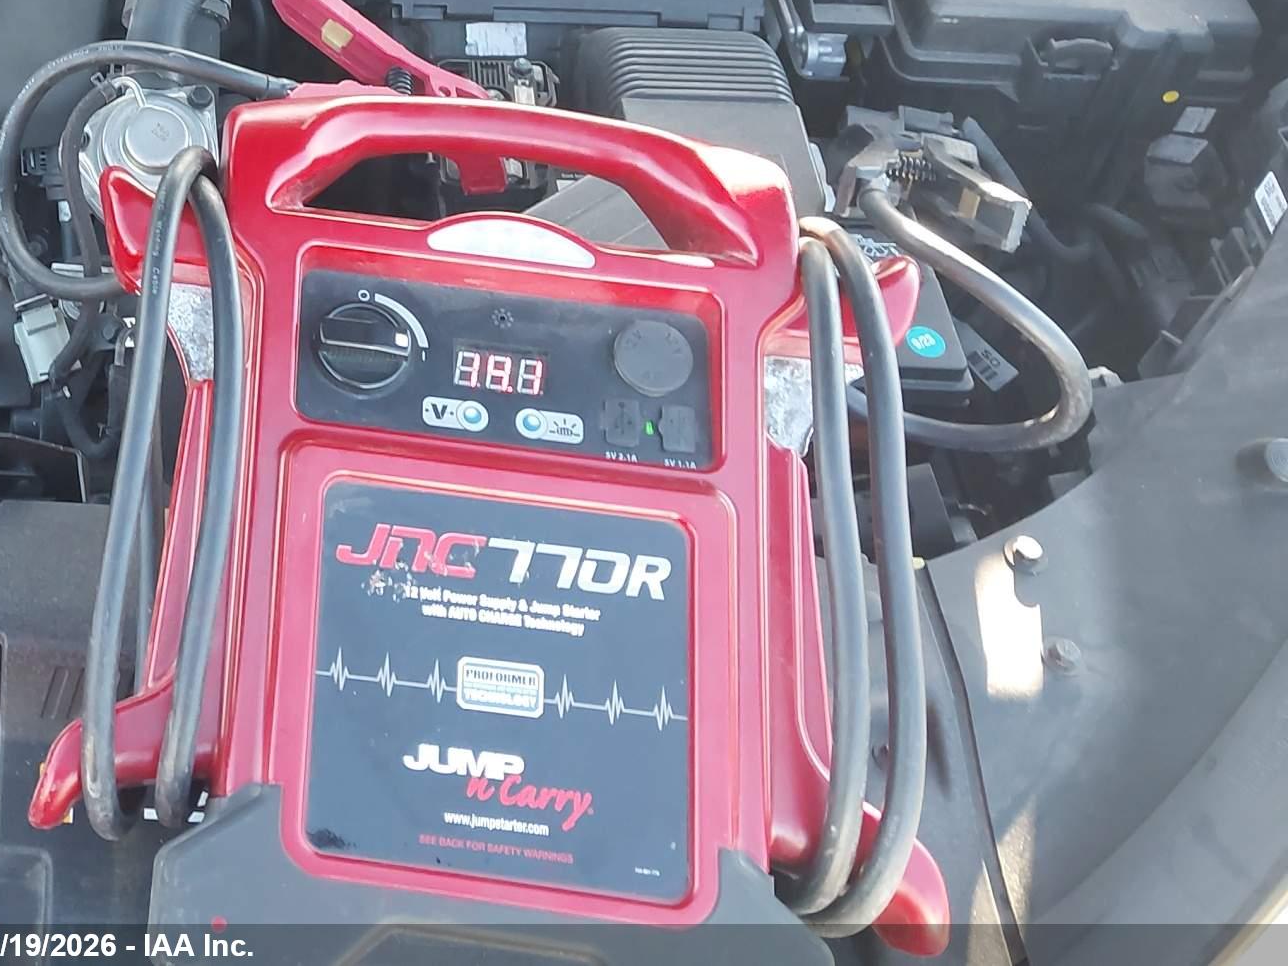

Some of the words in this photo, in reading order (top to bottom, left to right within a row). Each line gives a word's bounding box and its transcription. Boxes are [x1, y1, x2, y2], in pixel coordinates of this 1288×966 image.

[403, 743, 525, 781] JUMP
[499, 774, 593, 832] Carry
[444, 811, 549, 836] www.jumpstarter.com
[487, 842, 522, 856] SAFETY
